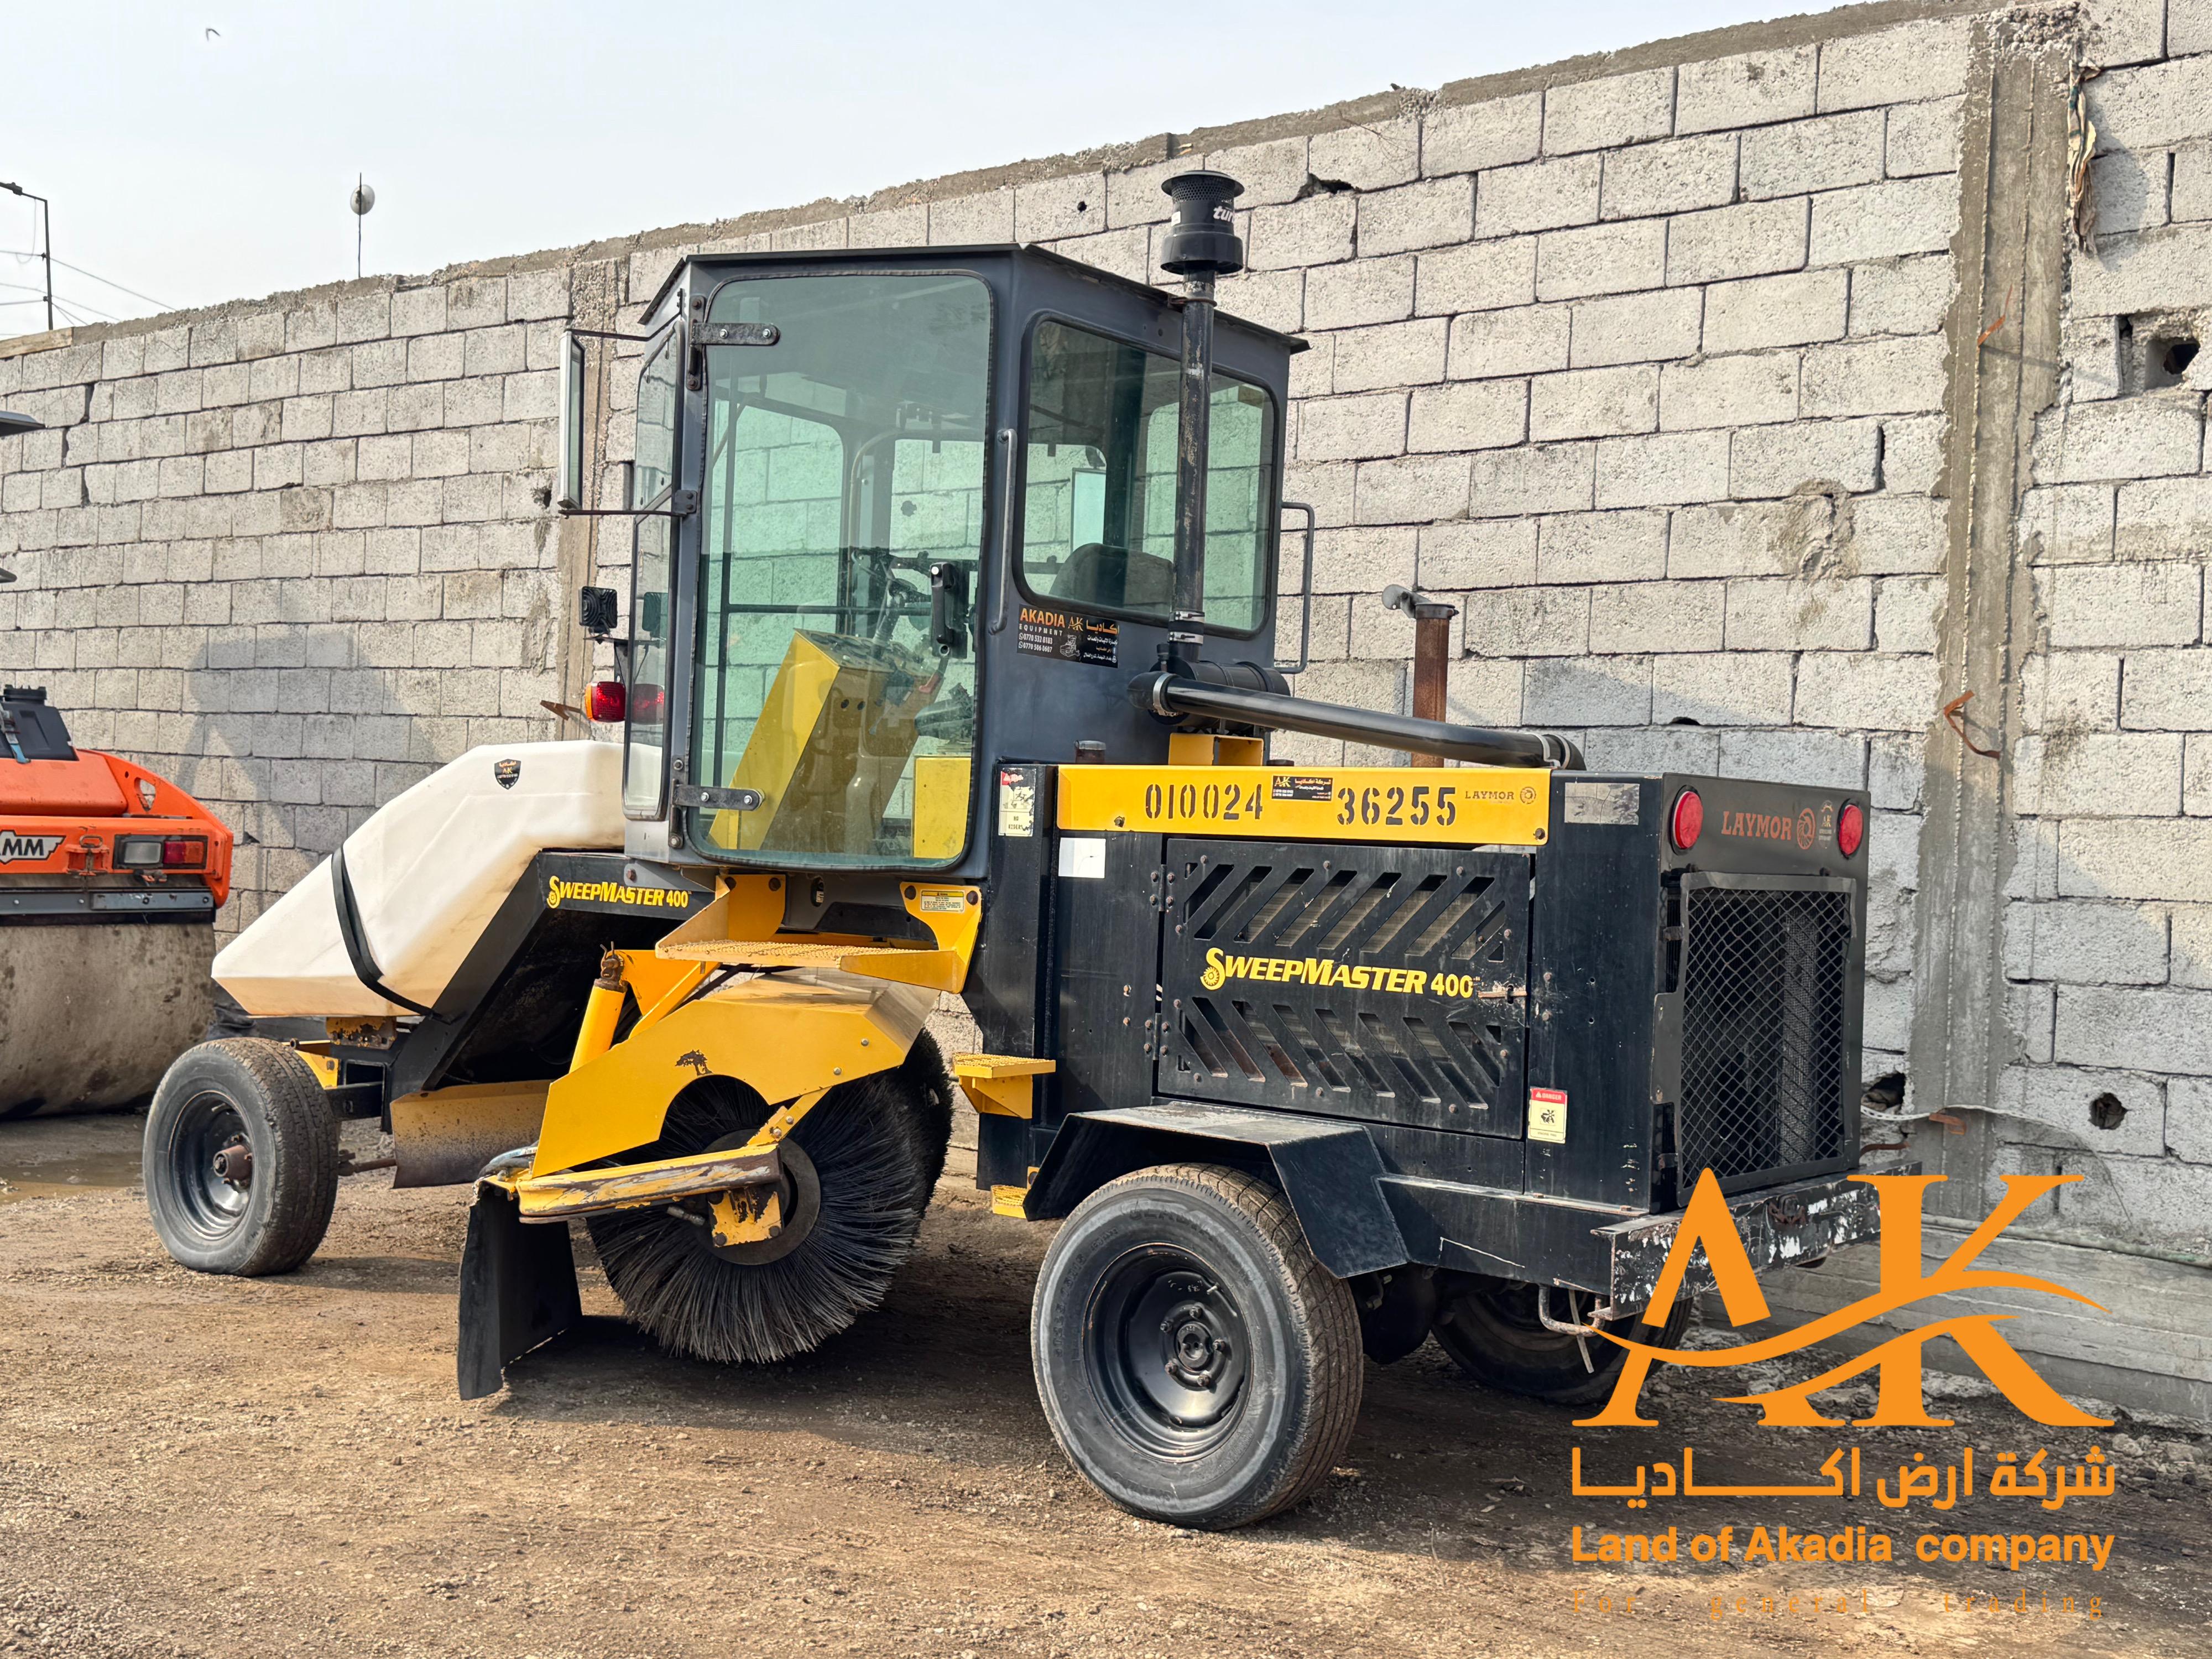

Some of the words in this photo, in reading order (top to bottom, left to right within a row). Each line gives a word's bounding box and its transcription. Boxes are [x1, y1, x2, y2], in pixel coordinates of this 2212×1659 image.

[1020, 608, 1066, 628] AKADIA
[1019, 623, 1063, 637] EQUIPMENT
[1274, 776, 1291, 787] AK
[1145, 784, 1263, 820] 010024
[1465, 791, 1514, 800] LAYMOR
[1337, 786, 1456, 826] 36255
[1721, 811, 1792, 841] LAYMOR
[0, 838, 44, 855] MM
[666, 890, 688, 908] 400
[1431, 973, 1473, 998] 400
